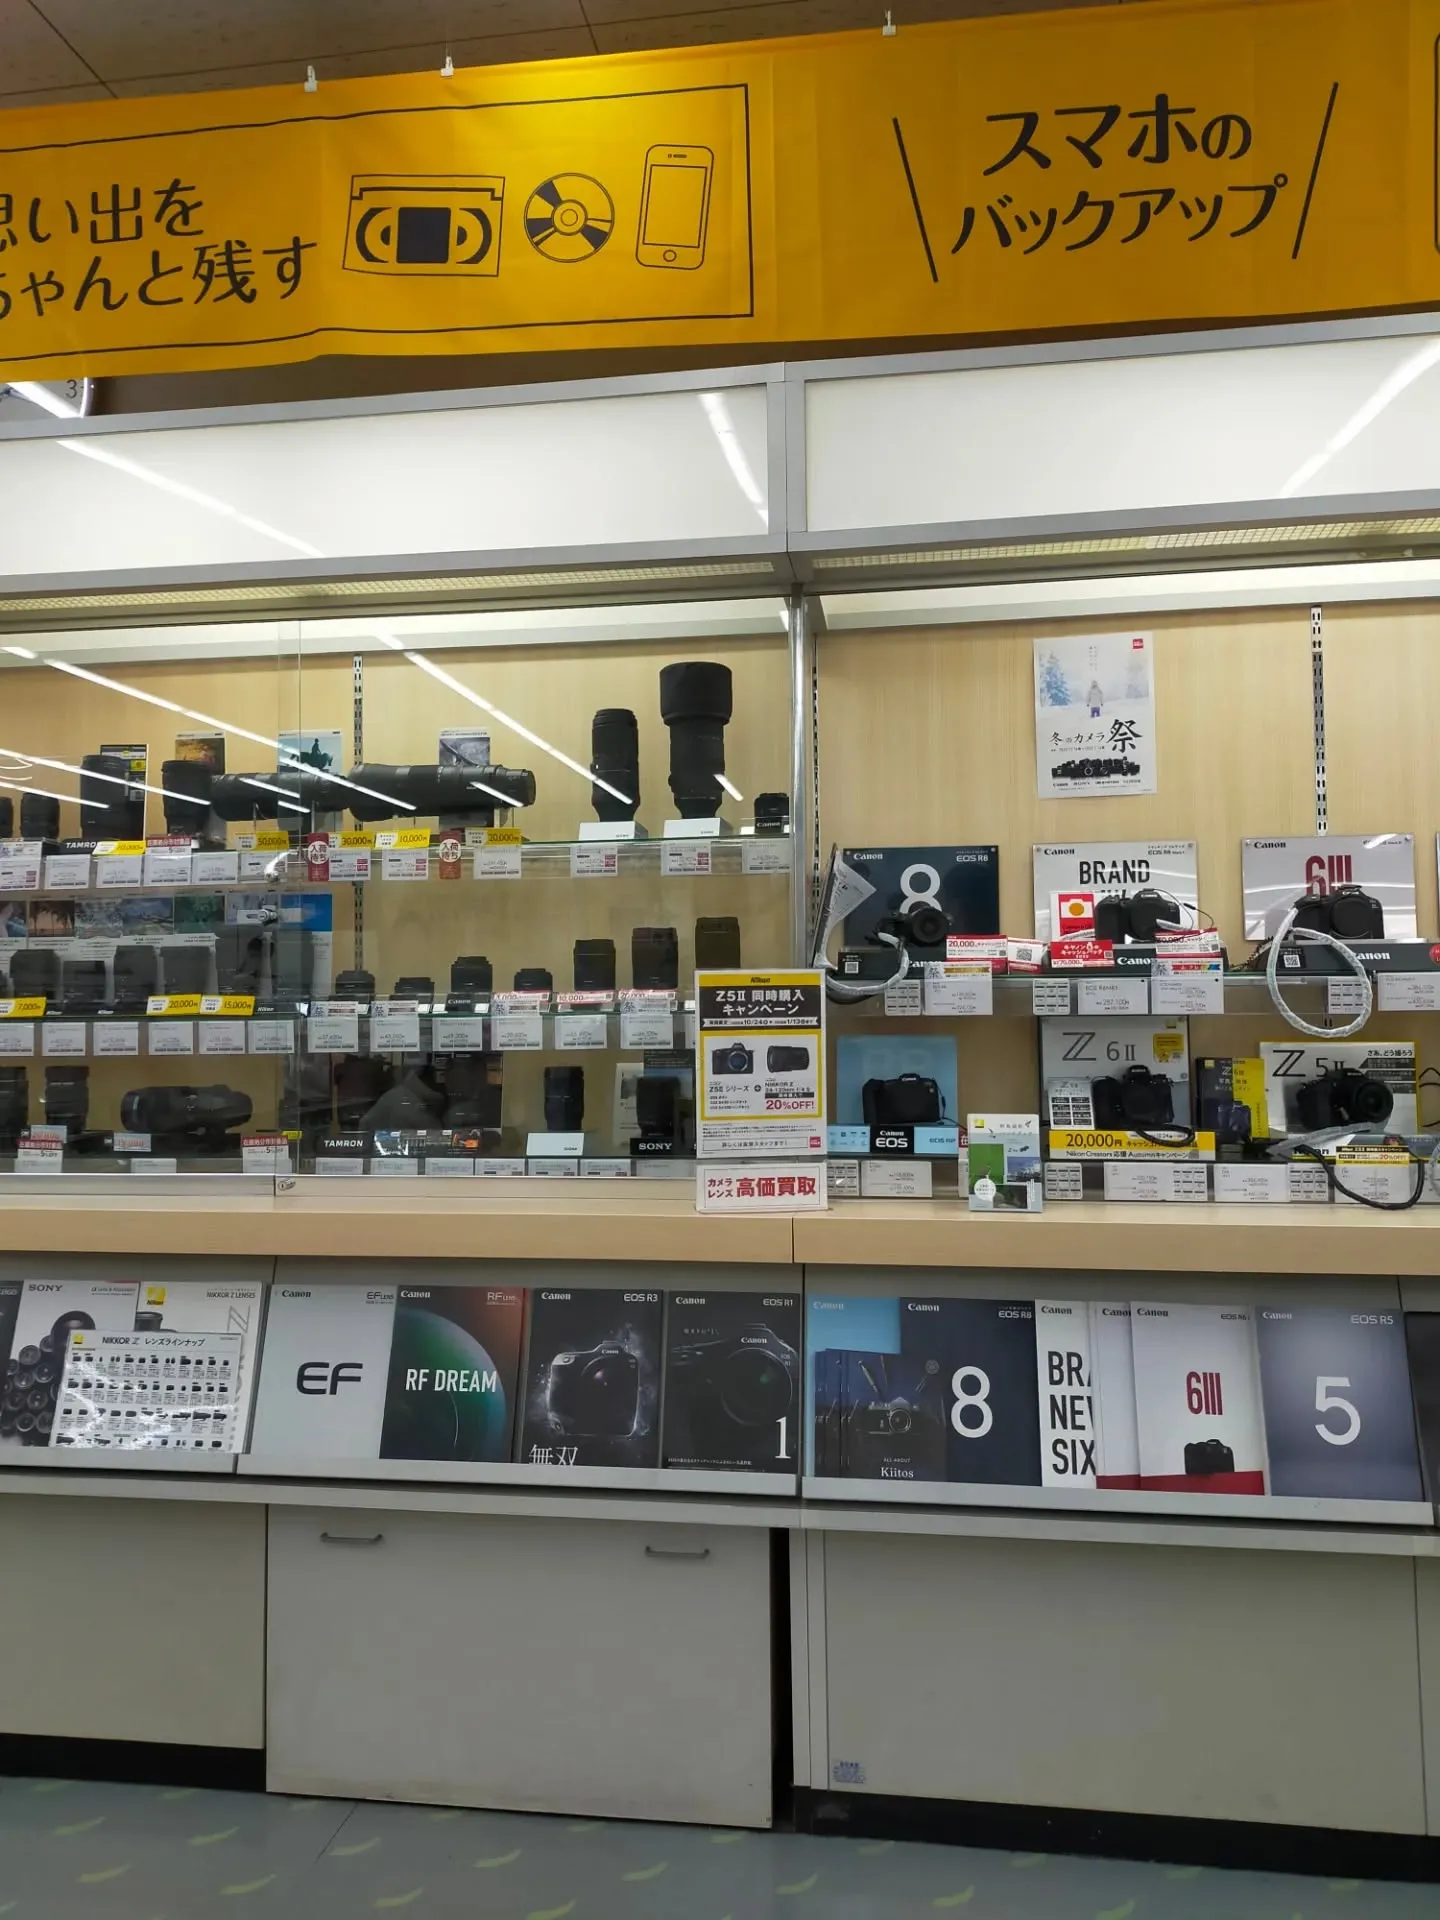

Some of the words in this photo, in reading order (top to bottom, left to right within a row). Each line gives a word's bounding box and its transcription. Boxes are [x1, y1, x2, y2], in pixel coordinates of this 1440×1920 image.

[983, 93, 1252, 176] スマホの
[951, 173, 1288, 255] バックアップ
[66, 841, 98, 849] TAMRO
[1253, 841, 1287, 849] Canon
[853, 852, 883, 860] Canon
[1044, 848, 1075, 856] Canon
[956, 854, 977, 862] EOS
[1079, 859, 1150, 885] BRAND
[1356, 952, 1391, 960] anon
[1117, 957, 1152, 966] Cano
[722, 1003, 799, 1016] キャンペーン
[1062, 1032, 1097, 1061] Z
[1272, 1050, 1306, 1077] Z
[324, 1139, 363, 1148] TAMRON
[875, 1138, 908, 1148] EOS
[1065, 1133, 1123, 1148] 20,000円
[638, 1142, 672, 1151] SONY
[707, 1178, 733, 1188] カメラ
[736, 1176, 816, 1198] 高価買取
[708, 1188, 734, 1199] レンズ
[28, 1284, 63, 1292] SONY
[281, 1289, 311, 1298] Canon
[367, 1291, 380, 1300] EF
[400, 1289, 431, 1298] Canon
[487, 1291, 502, 1301] RF
[541, 1291, 571, 1300] Canon
[624, 1293, 646, 1302] EOS
[647, 1293, 658, 1302] R3
[675, 1296, 705, 1305] Canon
[763, 1298, 783, 1306] EOS
[813, 1301, 844, 1311] Canon
[908, 1303, 940, 1312] Canon
[1041, 1305, 1073, 1315] Canon
[998, 1310, 1020, 1318] EOS
[1137, 1307, 1169, 1317] Canon
[1262, 1311, 1292, 1320] Canon
[1350, 1314, 1378, 1324] EOS
[1379, 1315, 1393, 1325] R5
[102, 1336, 130, 1345] NIKKOR
[145, 1337, 206, 1347] レンズラインナップ
[741, 1336, 768, 1344] Canon
[296, 1361, 363, 1395] EF
[405, 1368, 429, 1391] RF
[434, 1369, 497, 1393] DREAM
[1186, 1371, 1223, 1415] 6III
[951, 1365, 993, 1438] 8
[1315, 1376, 1361, 1446] 5
[775, 1416, 791, 1459] 1
[1051, 1438, 1097, 1475] SIX
[881, 1466, 914, 1478] Kiitos
